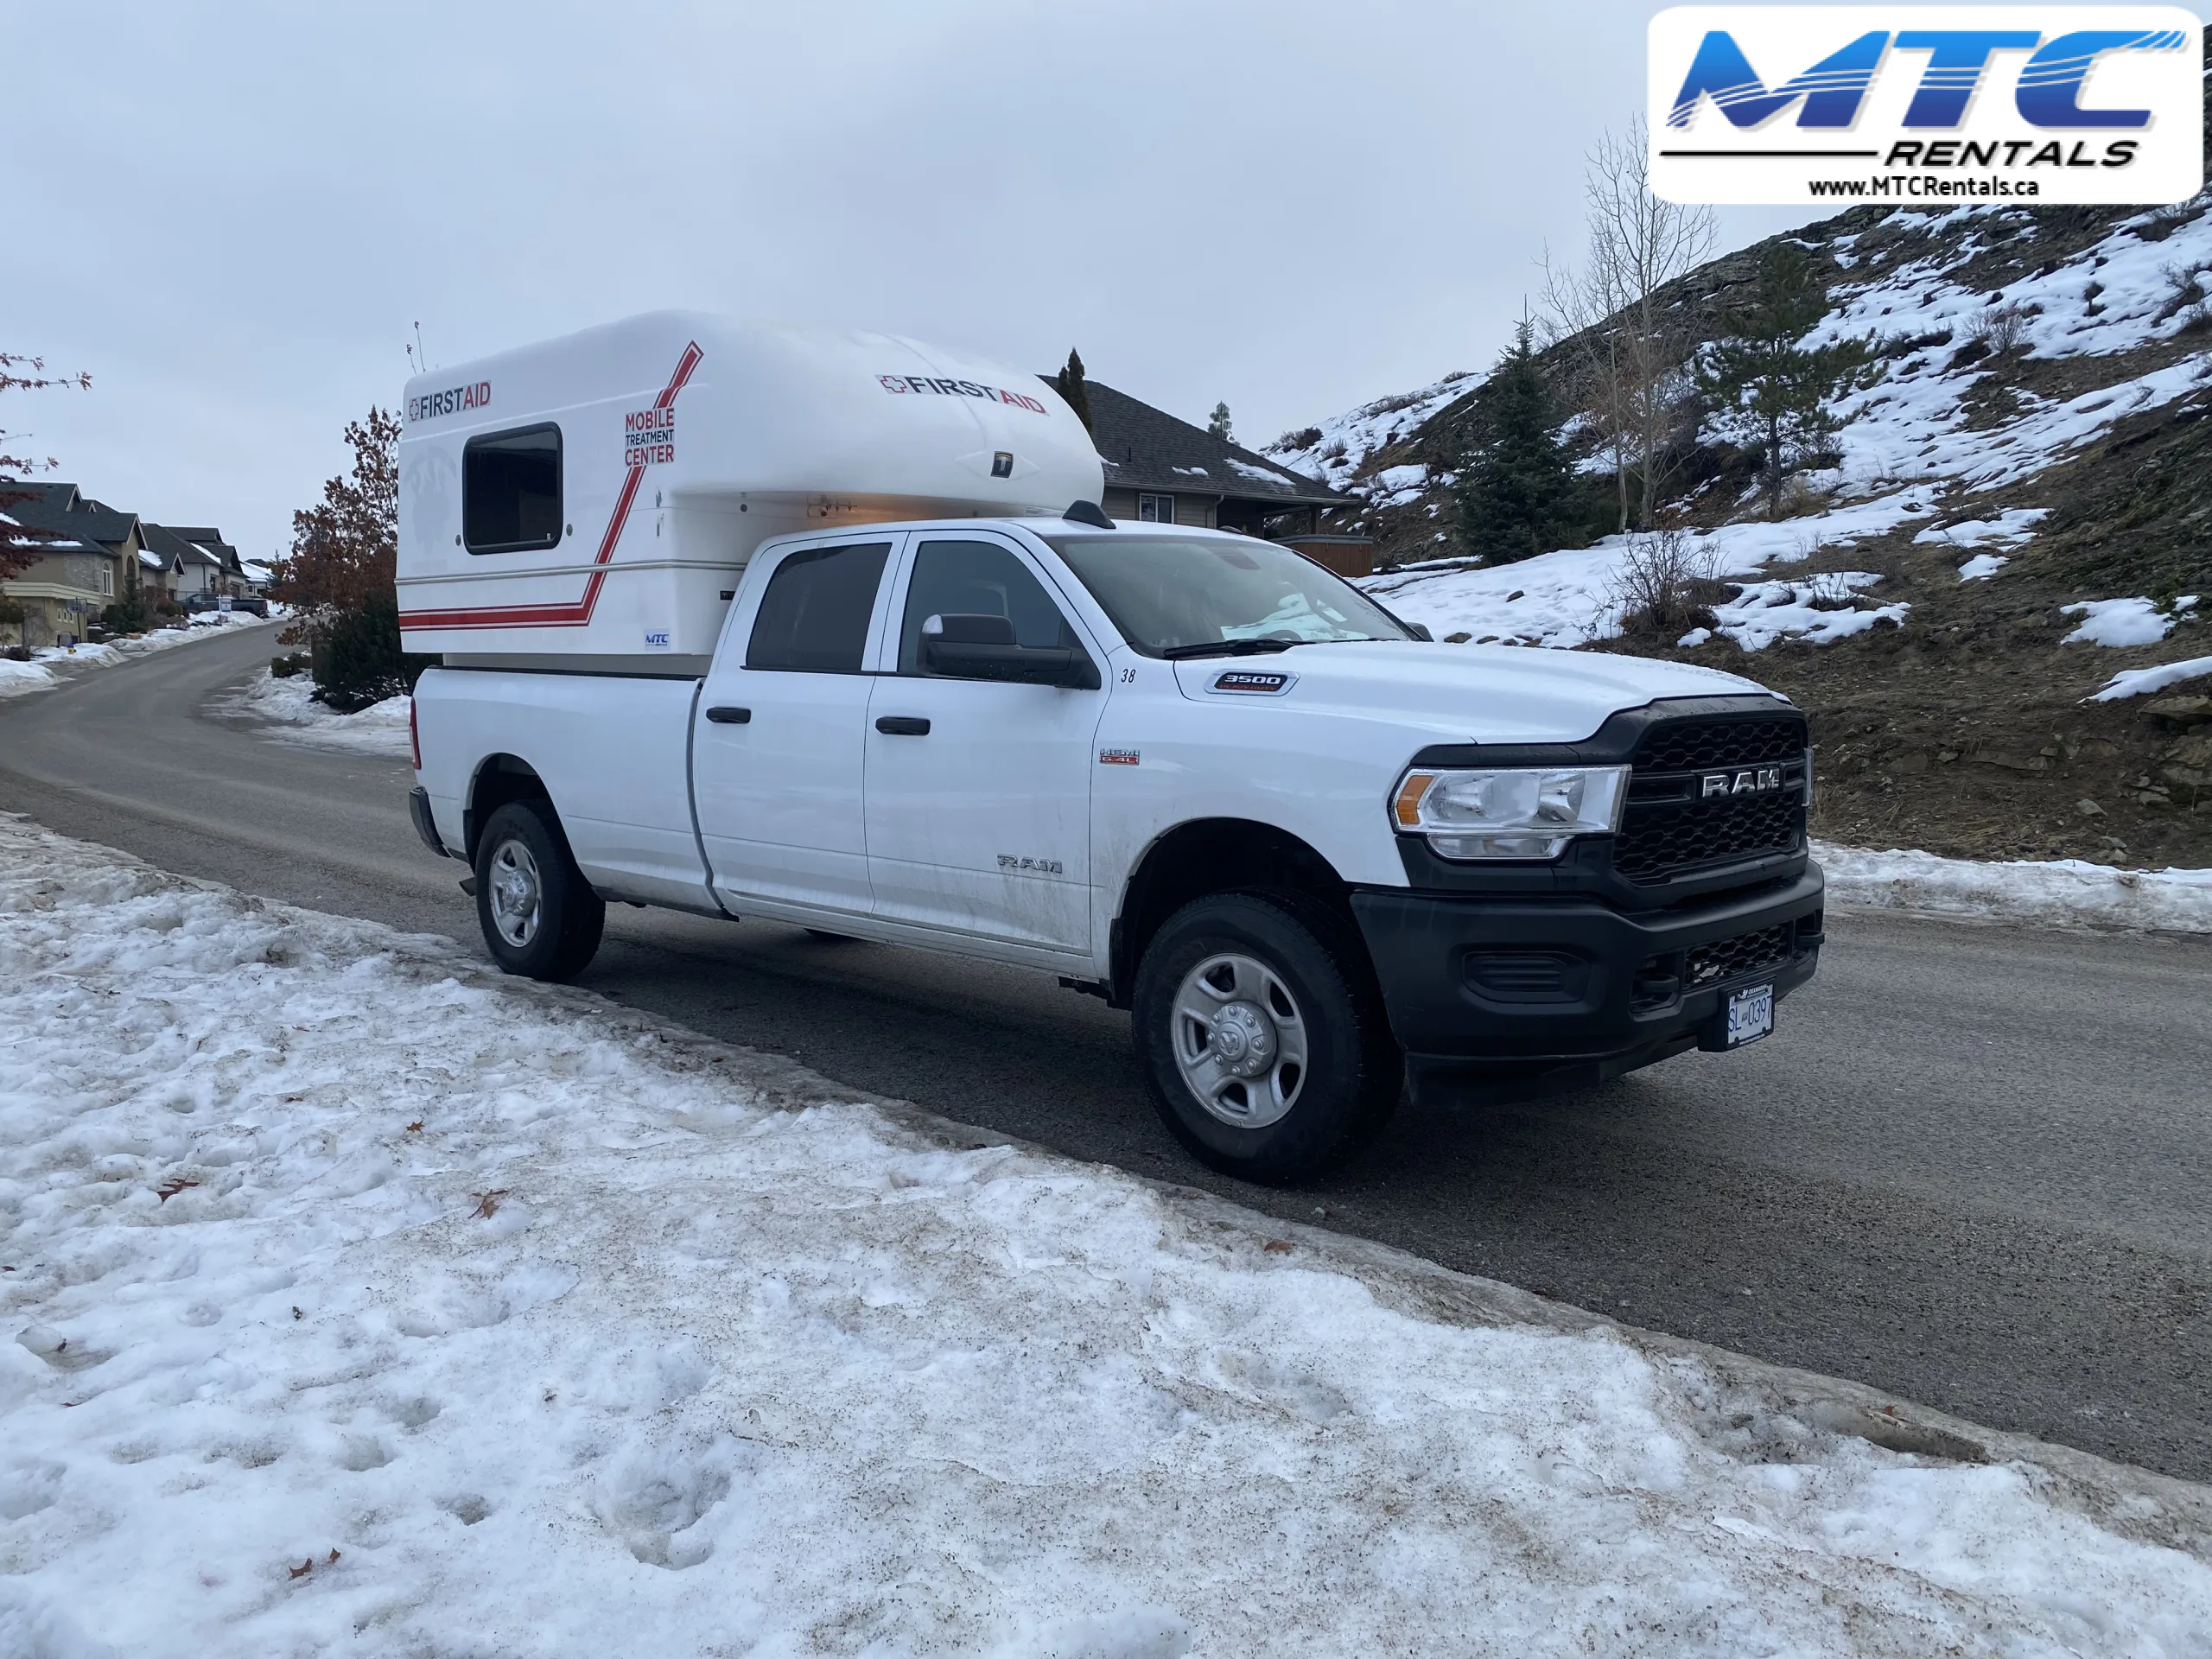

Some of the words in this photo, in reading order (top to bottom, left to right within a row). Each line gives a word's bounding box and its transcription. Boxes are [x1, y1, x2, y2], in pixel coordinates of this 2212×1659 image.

[626, 408, 674, 432] MOBILE
[626, 429, 674, 447] TREATMENT
[625, 444, 674, 467] CENTER
[645, 633, 669, 643] MTC
[1121, 668, 1136, 683] 38
[1224, 675, 1281, 684] 3500
[1700, 768, 1779, 798] RAM
[997, 854, 1063, 874] RAM
[1748, 995, 1772, 1026] 0397
